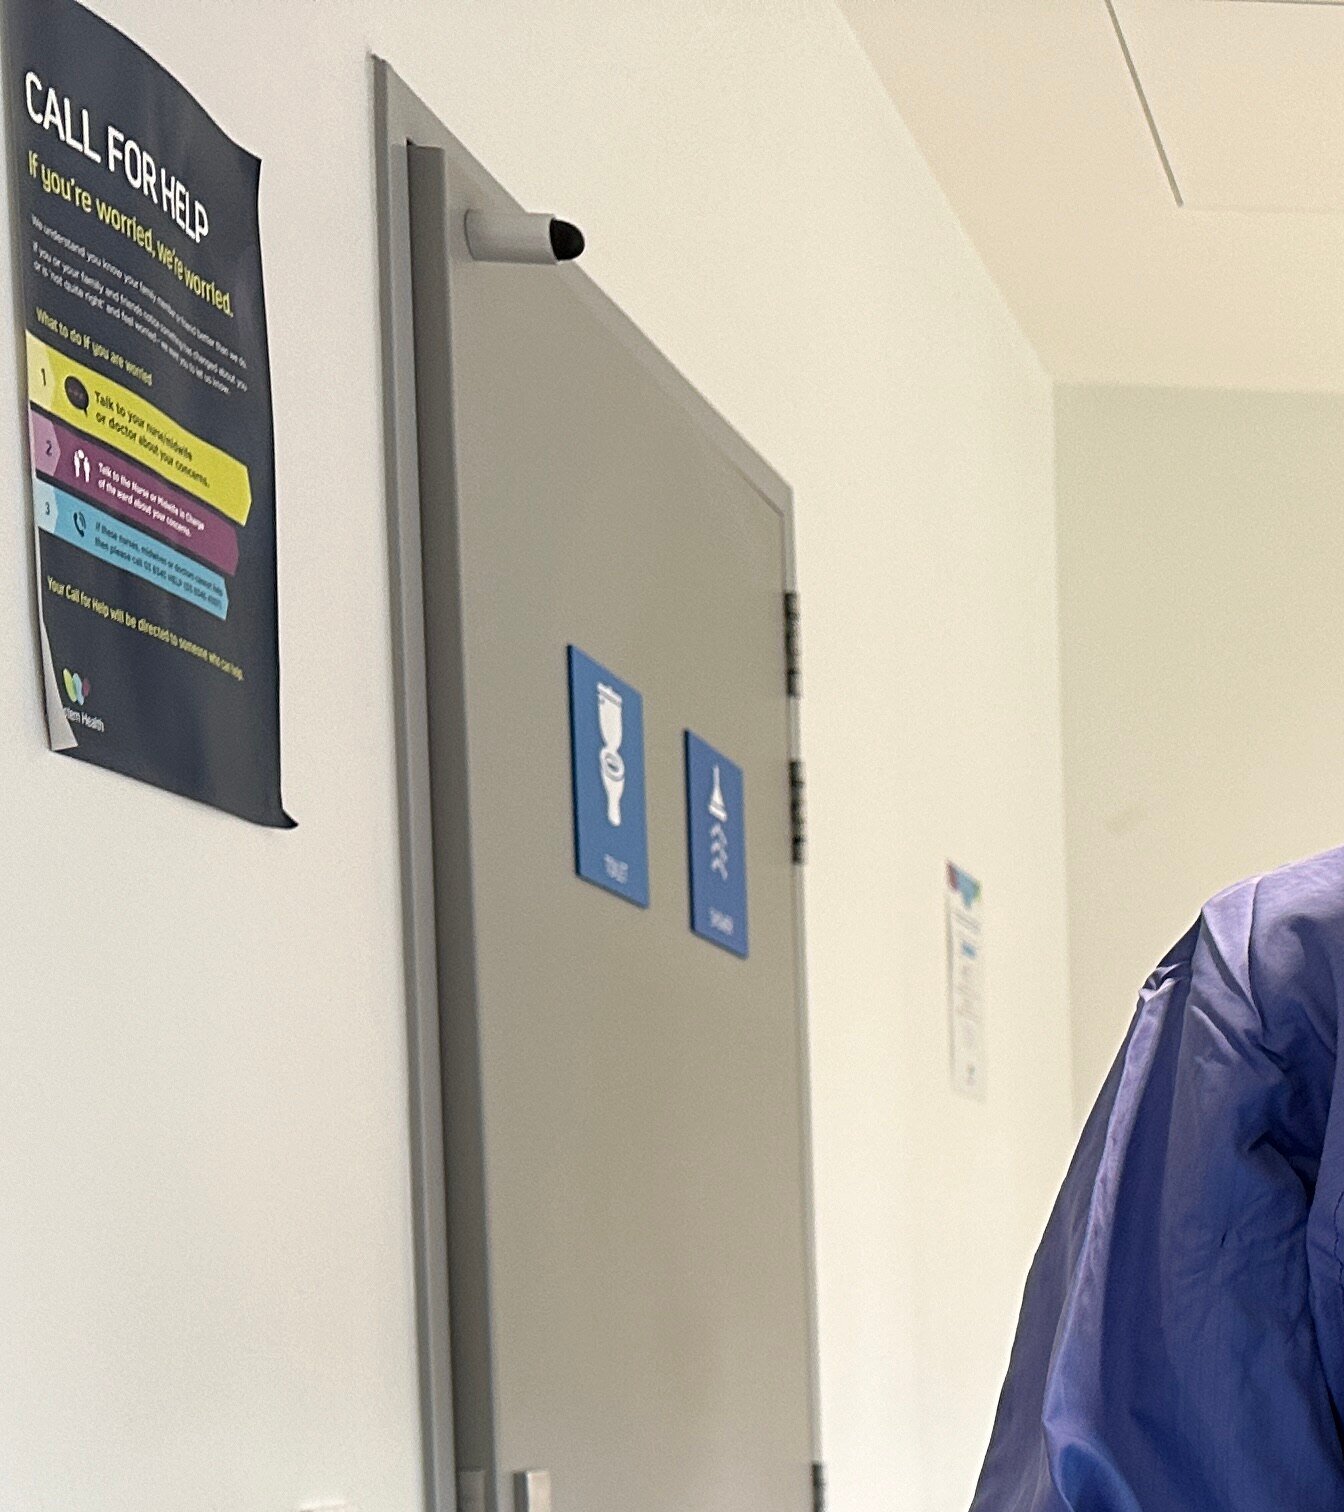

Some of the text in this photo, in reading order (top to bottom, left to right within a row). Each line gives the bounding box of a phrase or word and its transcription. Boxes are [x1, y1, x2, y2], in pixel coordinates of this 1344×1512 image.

[26, 71, 209, 243] CALL FOR HELP
[28, 150, 234, 317] If you're worried, we're worried.
[36, 306, 59, 333] What
[59, 321, 69, 339] to
[70, 329, 82, 346] do
[92, 341, 110, 357] you
[110, 351, 125, 369] are
[125, 360, 153, 387] worried
[41, 367, 47, 387] 1
[94, 390, 114, 412] Talk
[116, 402, 126, 418] to
[127, 410, 145, 429] your
[46, 440, 53, 456] 2
[96, 411, 106, 424] or
[108, 417, 137, 442] doctor
[138, 435, 159, 456] about
[159, 450, 174, 467] your
[98, 461, 112, 478] Talk
[112, 470, 120, 483] to
[120, 475, 131, 489] the
[45, 501, 51, 516] 3
[47, 575, 65, 597] Your
[66, 584, 80, 604] Call
[80, 591, 91, 609] for
[92, 596, 109, 619] Help
[81, 711, 105, 733] Health
